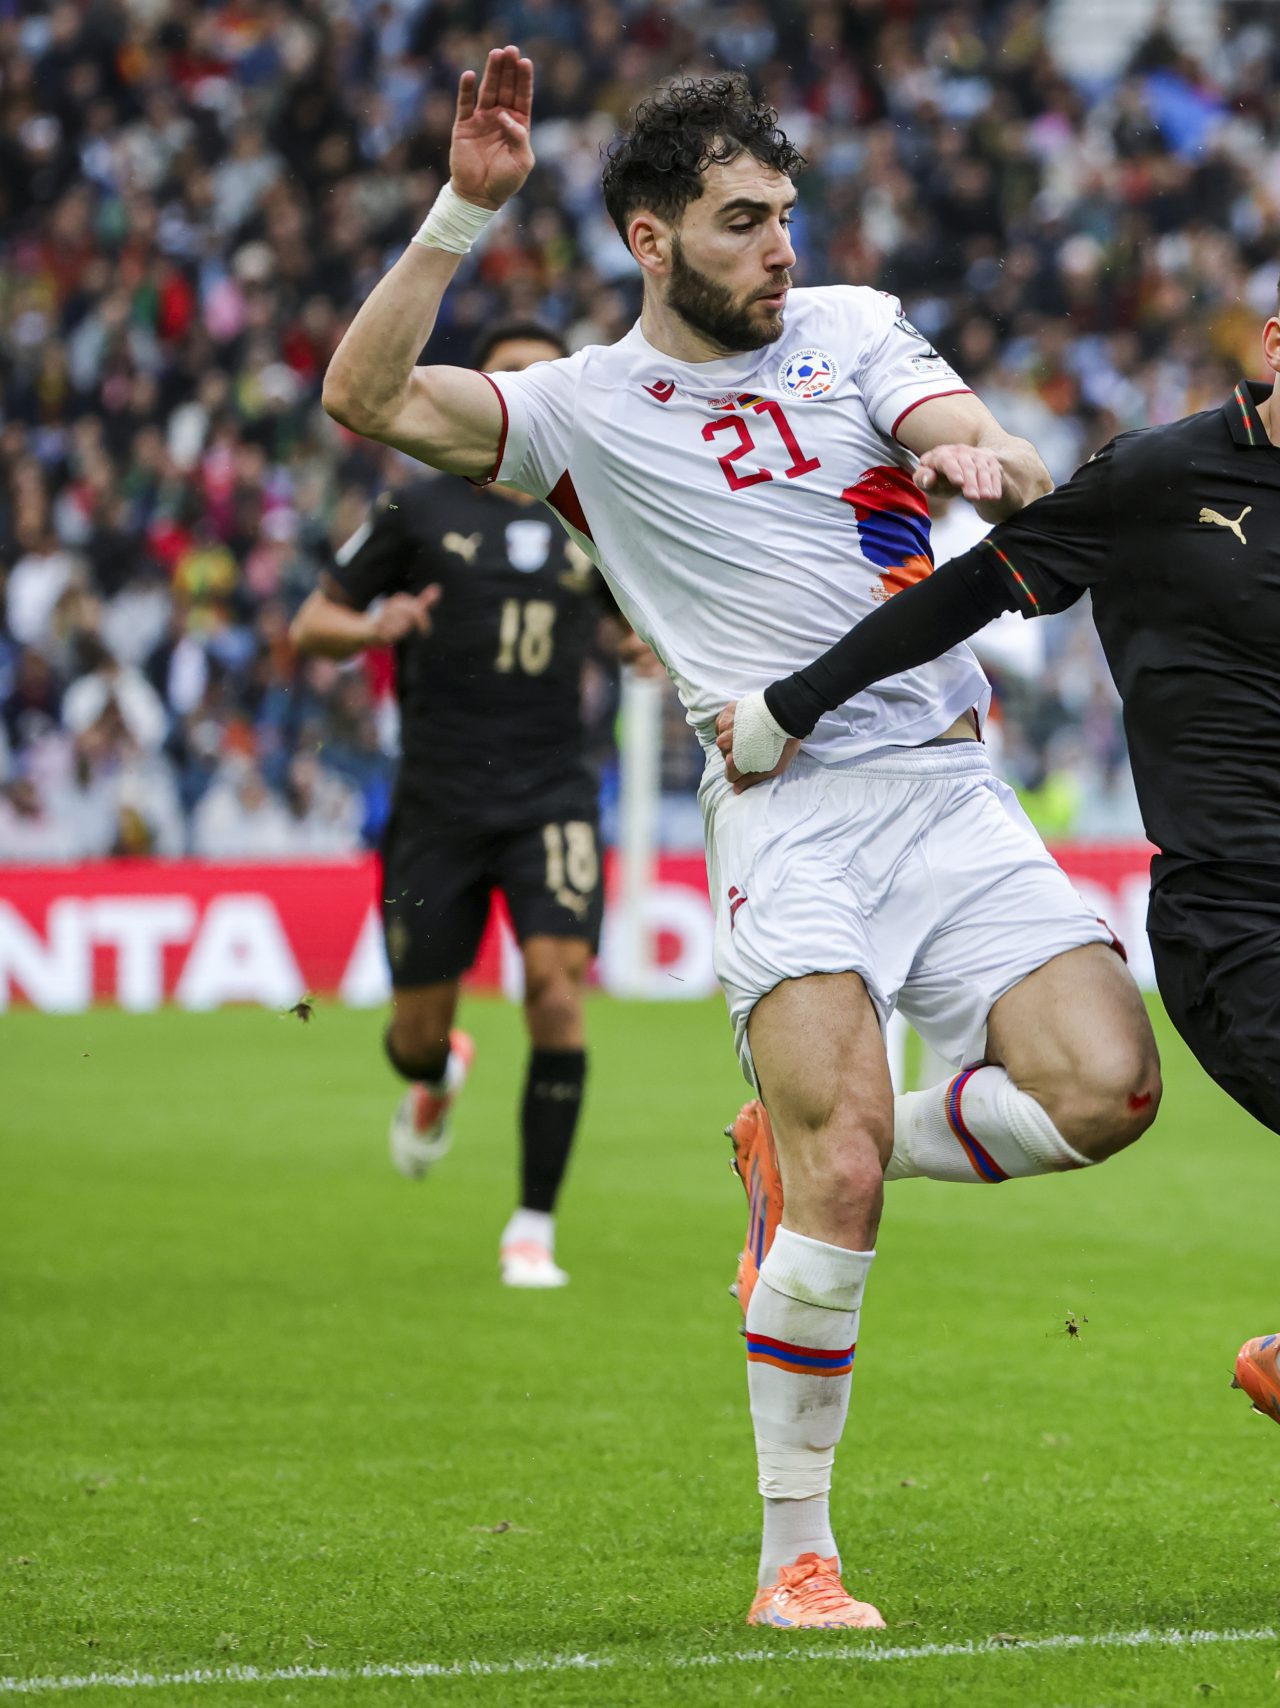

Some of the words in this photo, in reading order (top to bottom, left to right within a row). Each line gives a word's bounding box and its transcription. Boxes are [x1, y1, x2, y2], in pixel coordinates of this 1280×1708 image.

[701, 401, 821, 491] 21
[495, 599, 557, 677] 18
[543, 819, 600, 894] 18
